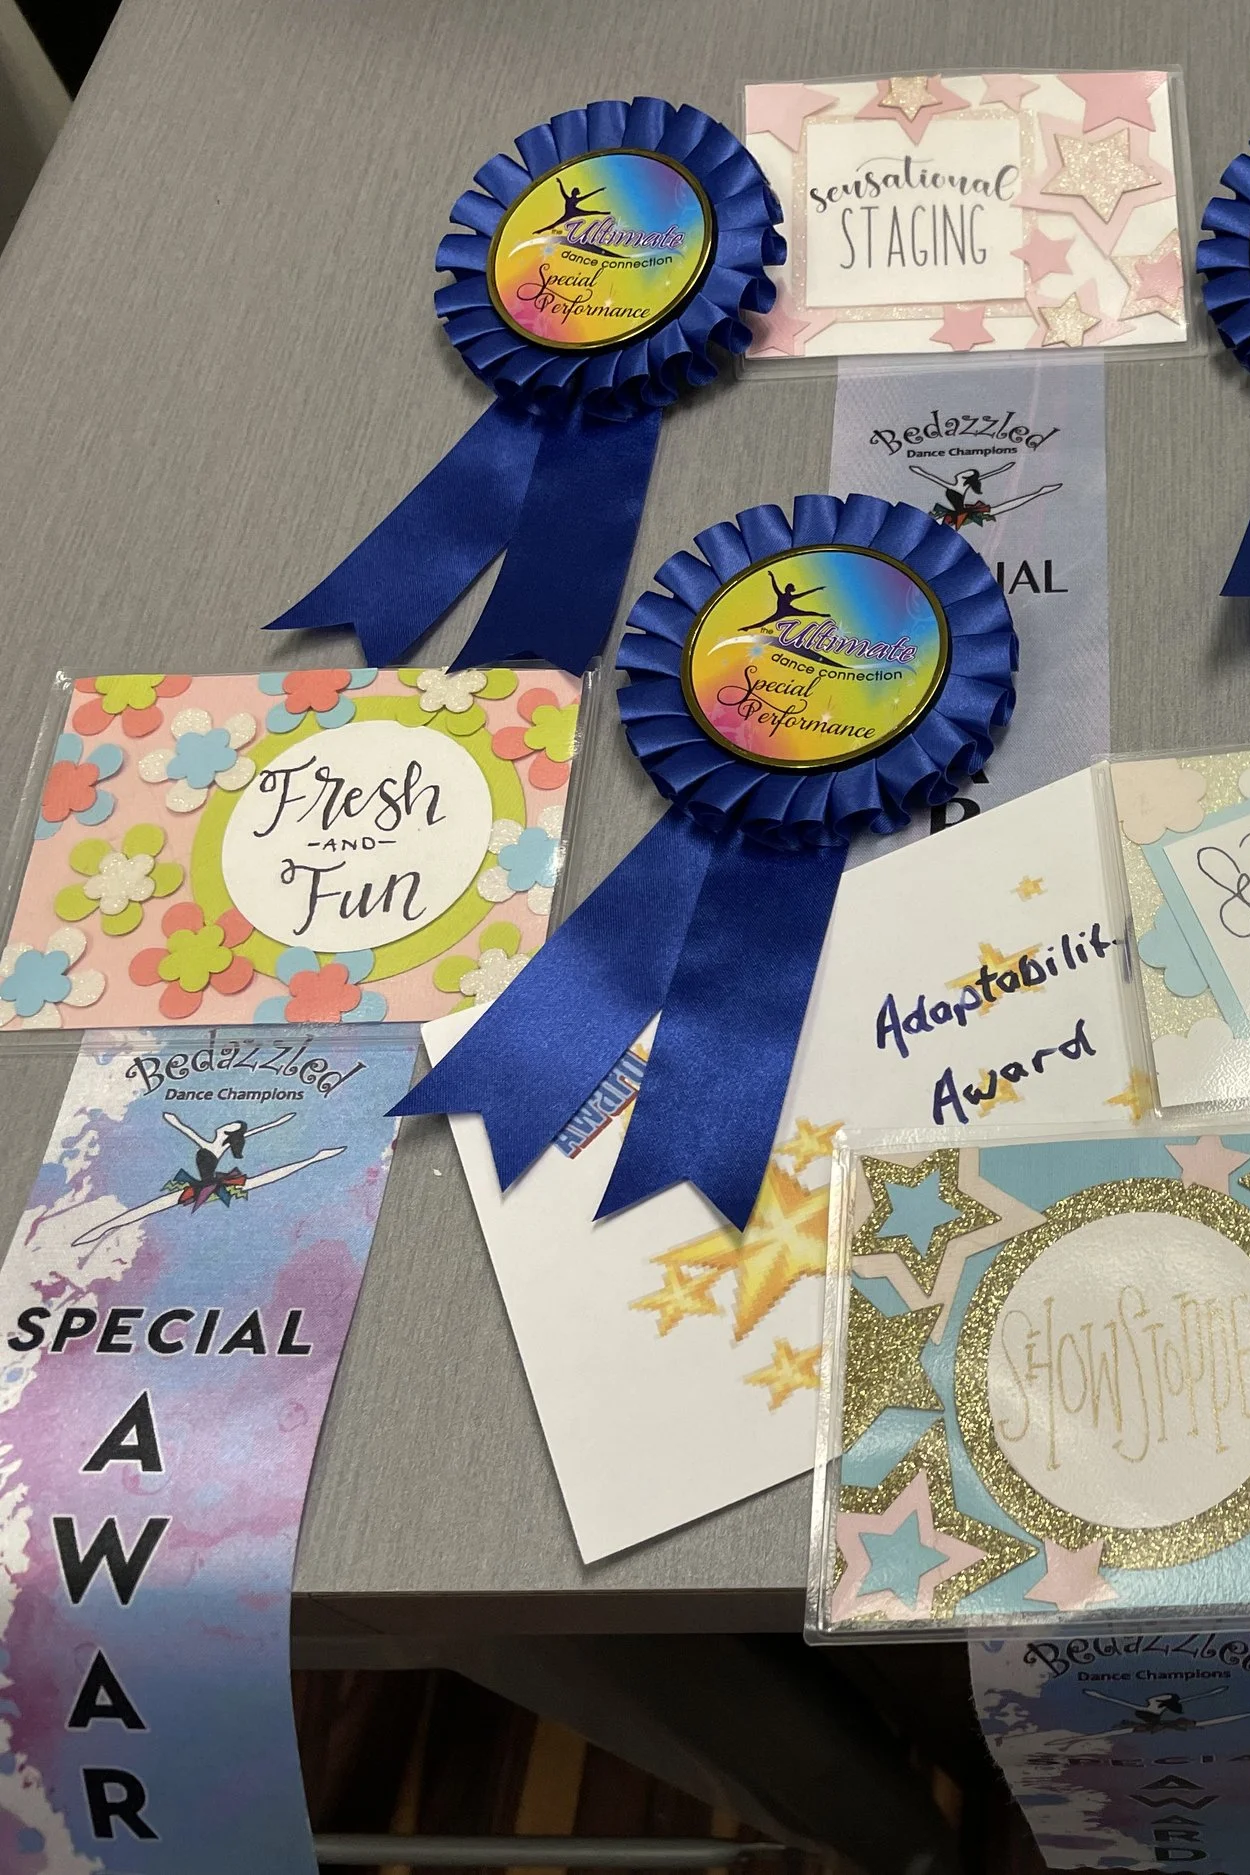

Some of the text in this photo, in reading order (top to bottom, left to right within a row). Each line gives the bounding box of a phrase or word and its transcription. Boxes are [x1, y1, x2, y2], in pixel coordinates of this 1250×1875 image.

[809, 155, 1019, 214] sensational
[564, 215, 685, 249] Ultimate
[840, 204, 987, 269] STAGING
[516, 263, 604, 301] Special
[561, 250, 673, 269] dance connection
[534, 293, 651, 325] Performance
[869, 410, 1061, 456] Bedazzled
[906, 446, 1018, 459] Dance Champions
[776, 619, 918, 664] Ultimate
[717, 665, 821, 713] Special
[771, 652, 902, 682] dance connection
[737, 699, 876, 738] Performance
[253, 755, 446, 838] Fresh
[281, 859, 427, 936] Fun
[125, 1029, 367, 1098] Bedazzled
[932, 1018, 1097, 1125] Award
[165, 1087, 304, 1103] Dance Champions
[7, 1305, 313, 1356] SPECIAL
[50, 1388, 170, 1841] AWAR
[1077, 1667, 1231, 1682] Dance Champions
[1128, 1773, 1221, 1863] AWARD
